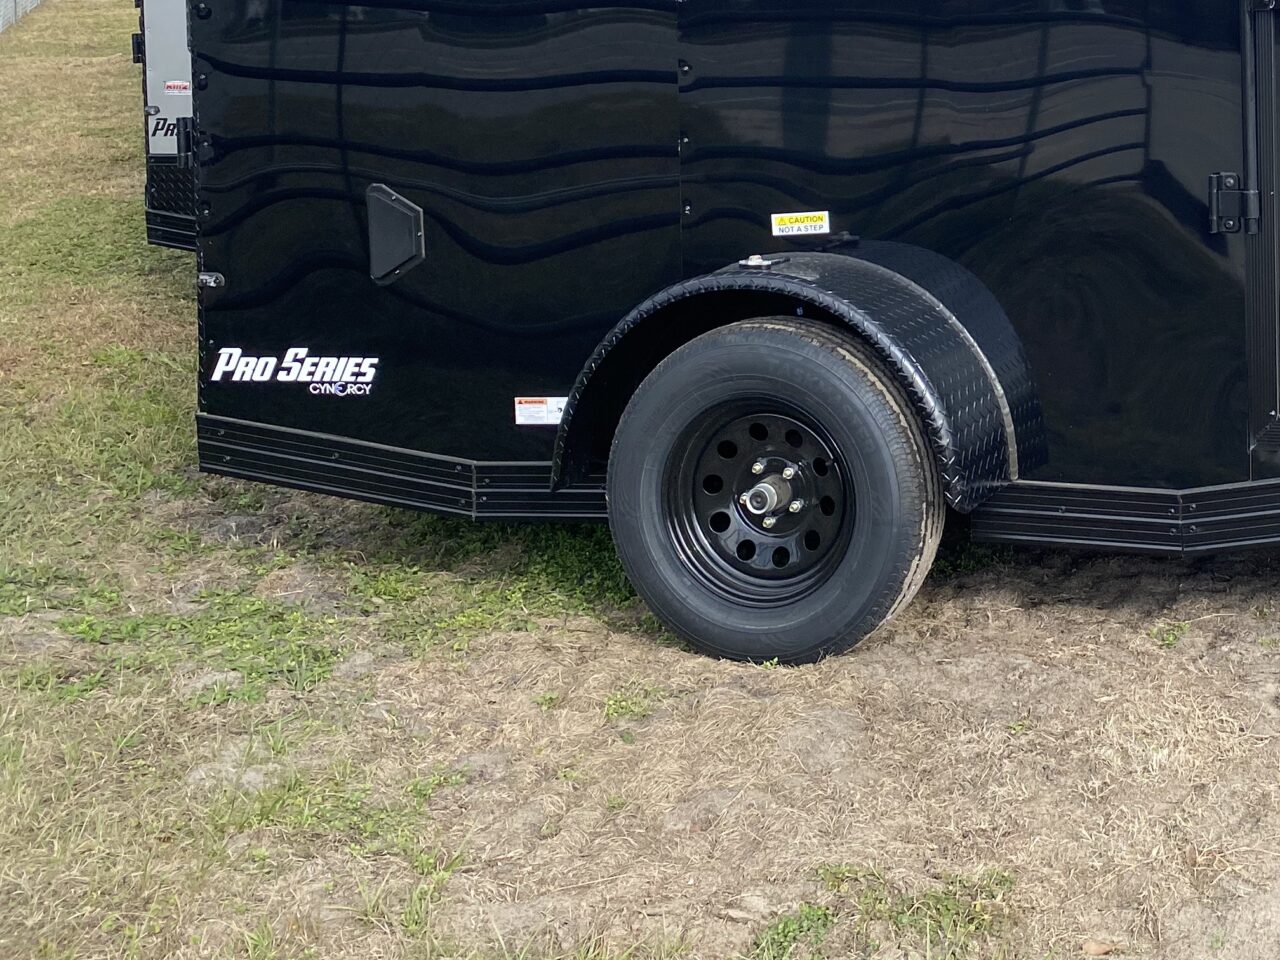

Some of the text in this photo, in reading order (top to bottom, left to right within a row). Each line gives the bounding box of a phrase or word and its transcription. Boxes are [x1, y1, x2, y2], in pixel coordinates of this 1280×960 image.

[151, 117, 178, 137] PR
[788, 215, 823, 224] CAUTION
[803, 224, 824, 232] STEP
[211, 347, 379, 383] PRO SERIES
